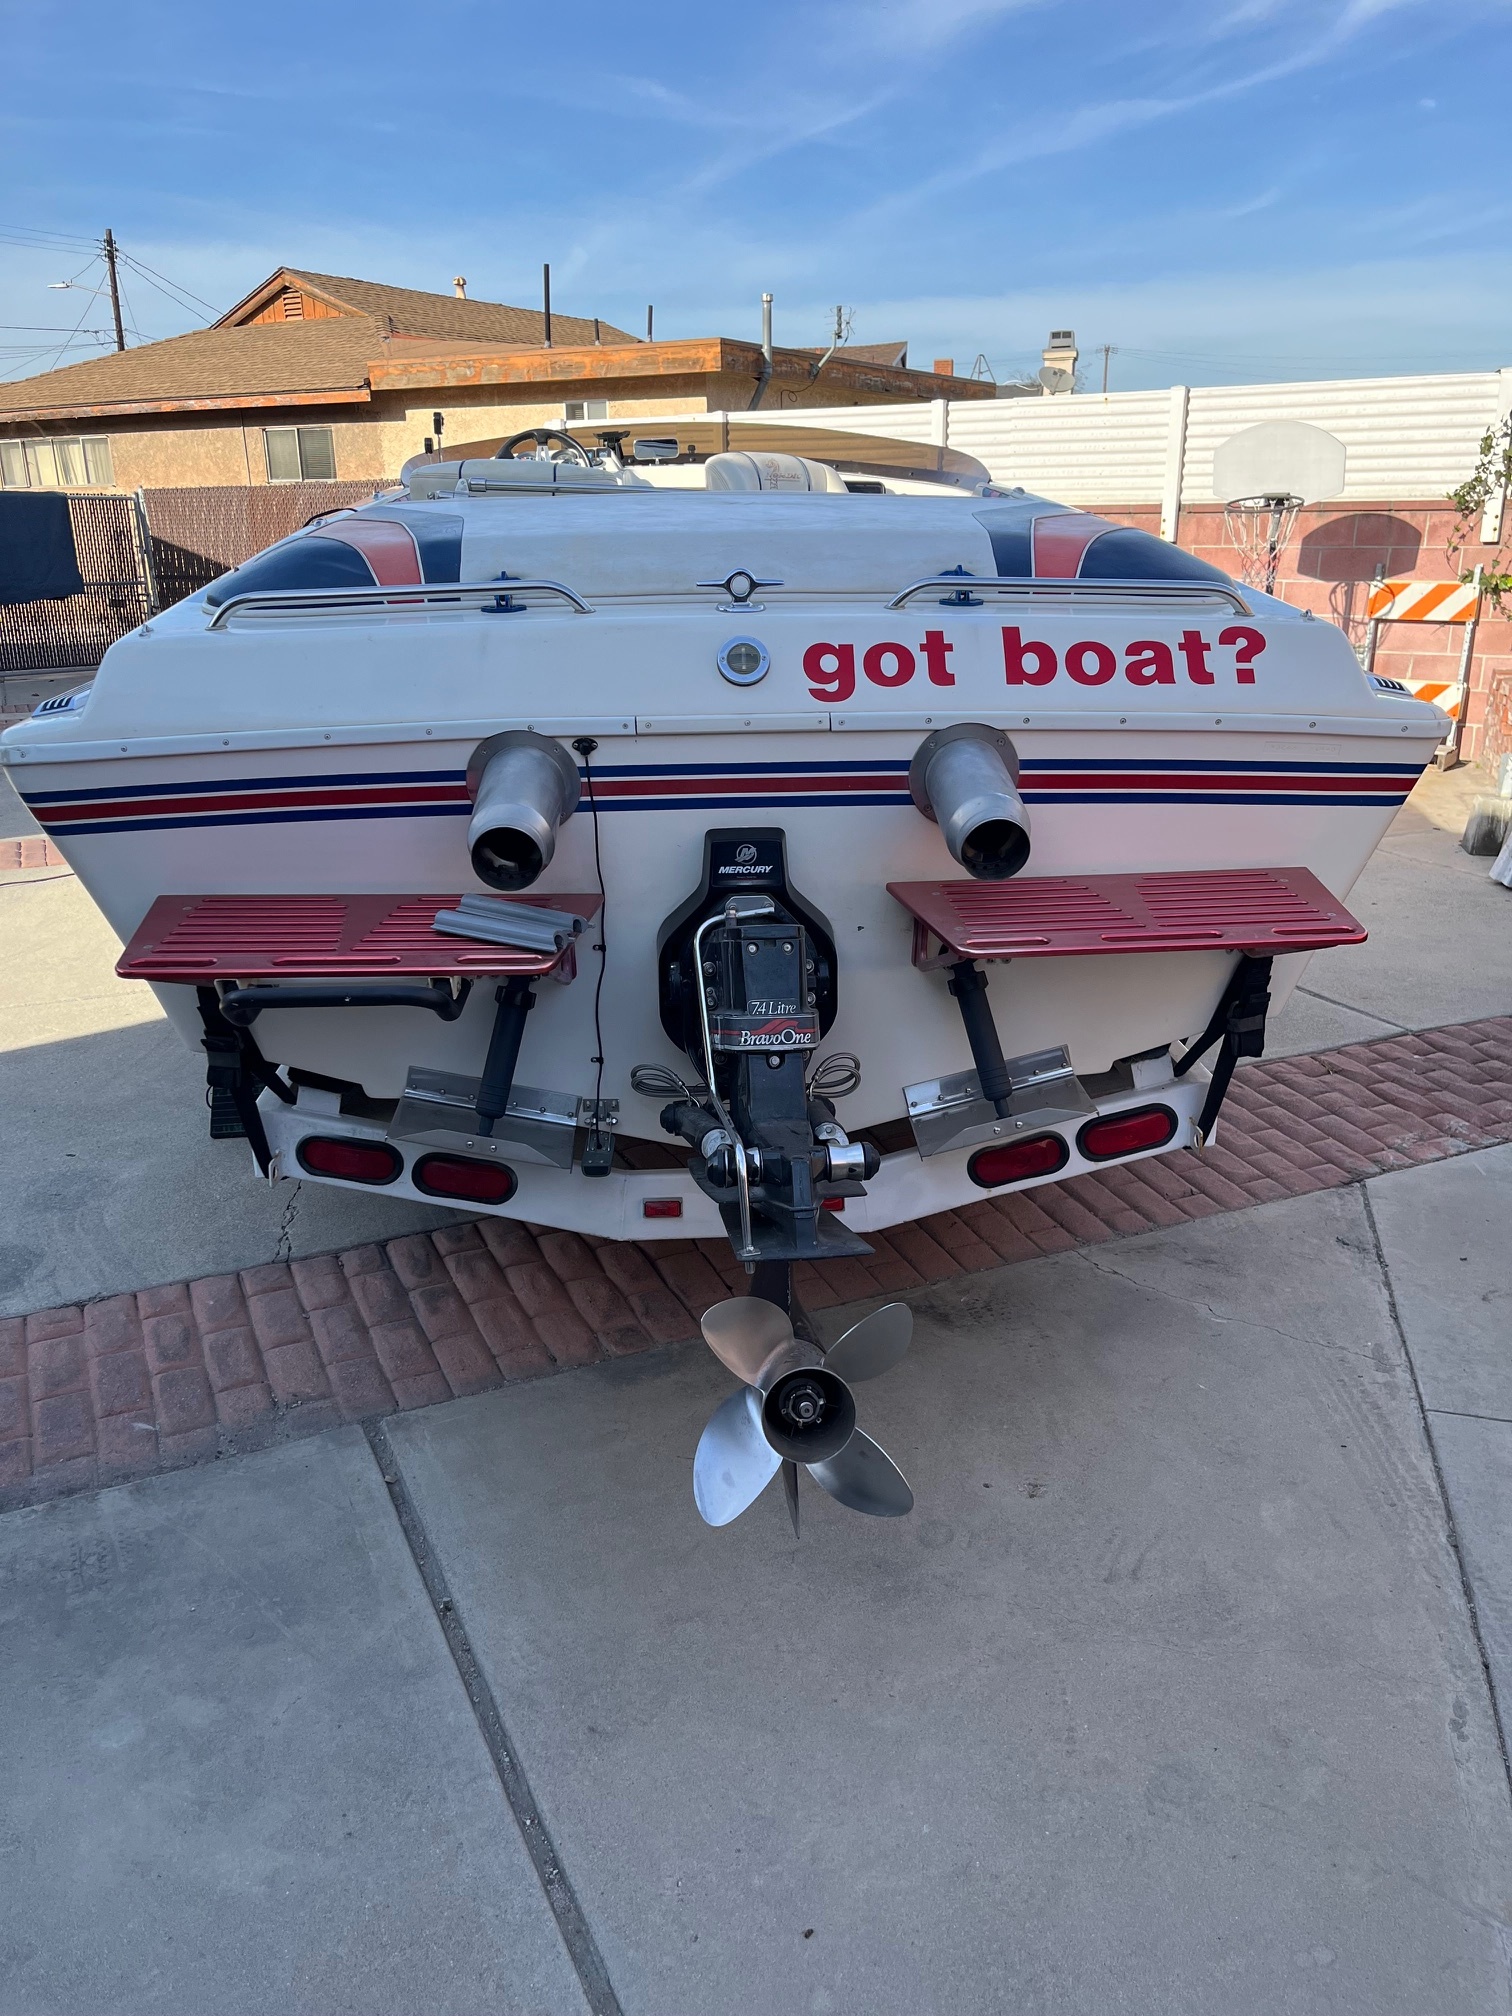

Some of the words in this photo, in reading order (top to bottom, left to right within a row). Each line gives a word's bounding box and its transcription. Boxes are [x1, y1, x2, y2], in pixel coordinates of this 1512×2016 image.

[802, 629, 956, 703] got
[1001, 625, 1267, 687] boat?
[718, 865, 773, 874] MERCURY
[768, 1001, 797, 1015] Litre
